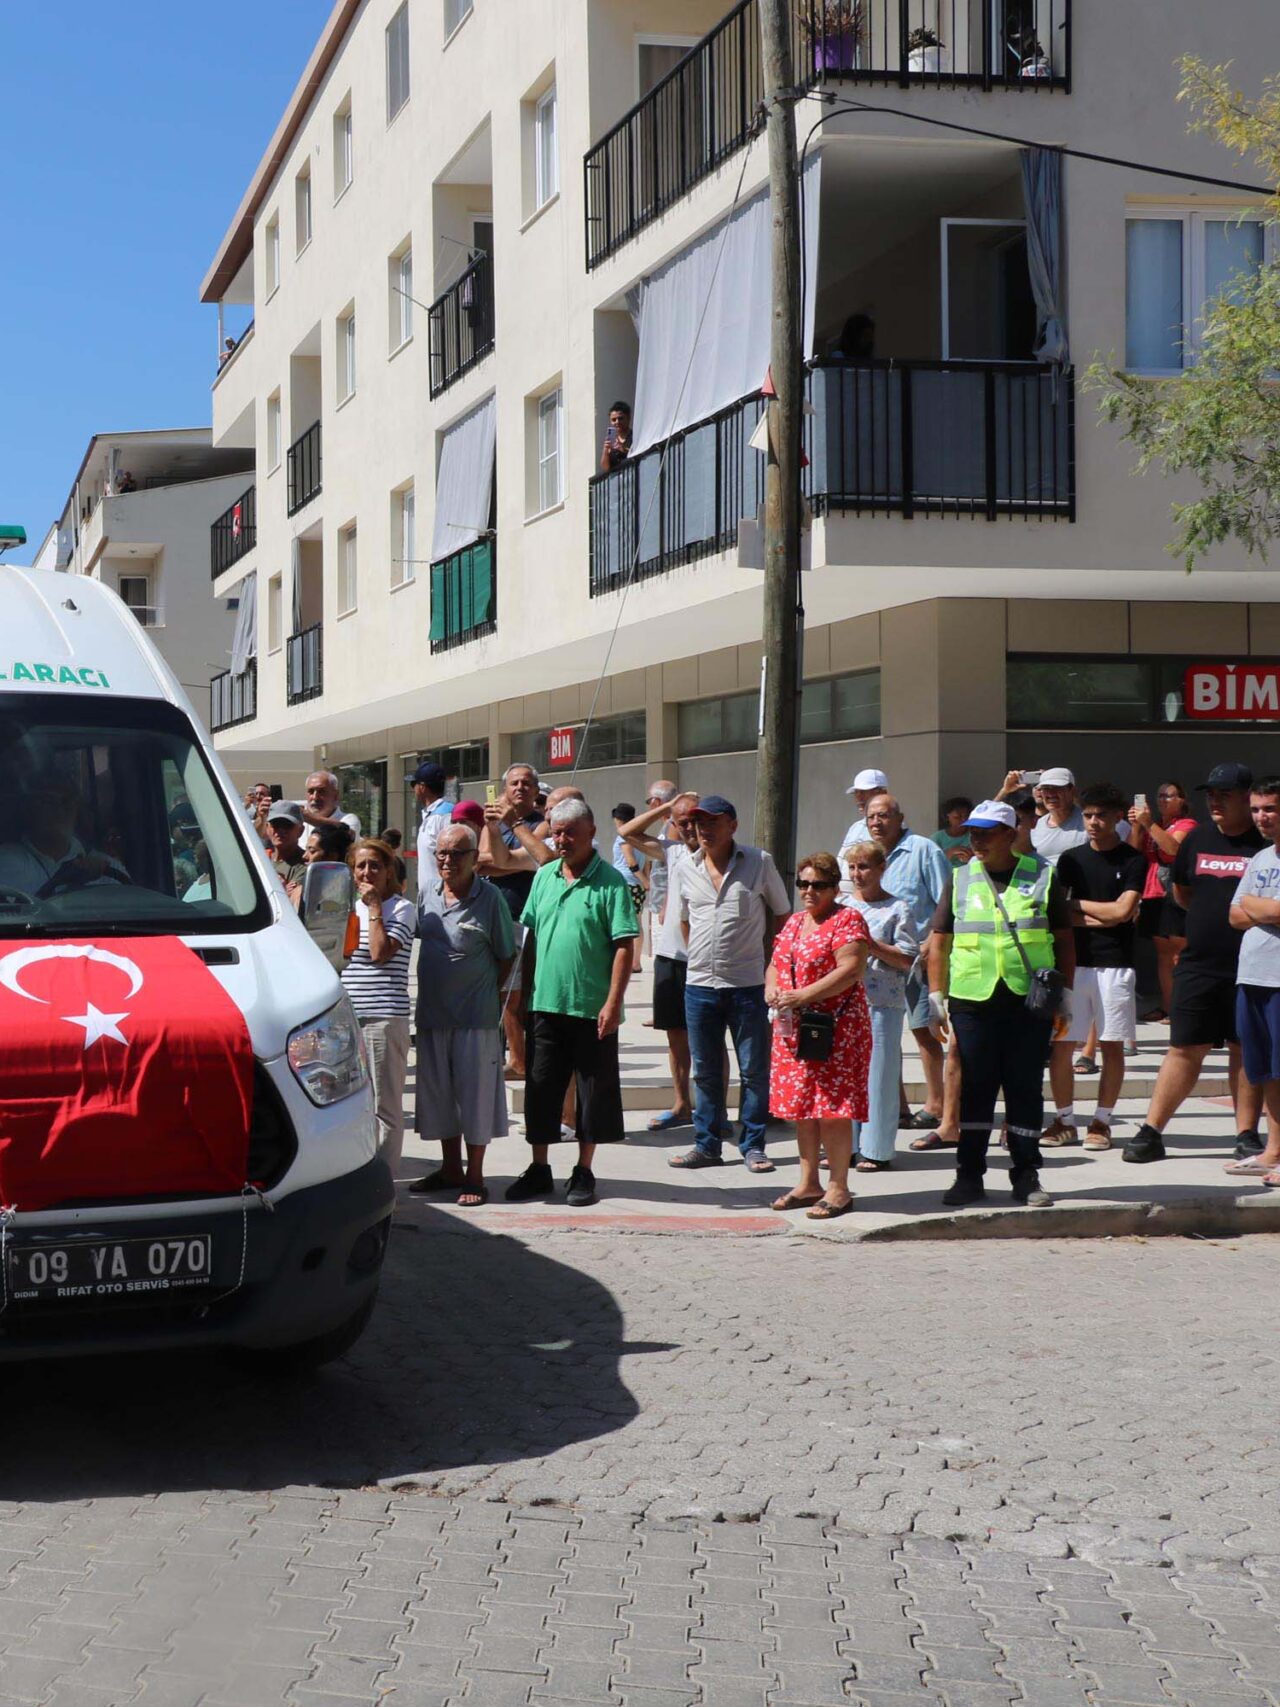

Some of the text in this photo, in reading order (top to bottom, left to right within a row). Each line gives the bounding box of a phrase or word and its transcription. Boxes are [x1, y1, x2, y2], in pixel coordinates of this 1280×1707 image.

[29, 1240, 205, 1284] 09 YA 070
[57, 1285, 94, 1297] RIFAT
[96, 1283, 123, 1294] OTO
